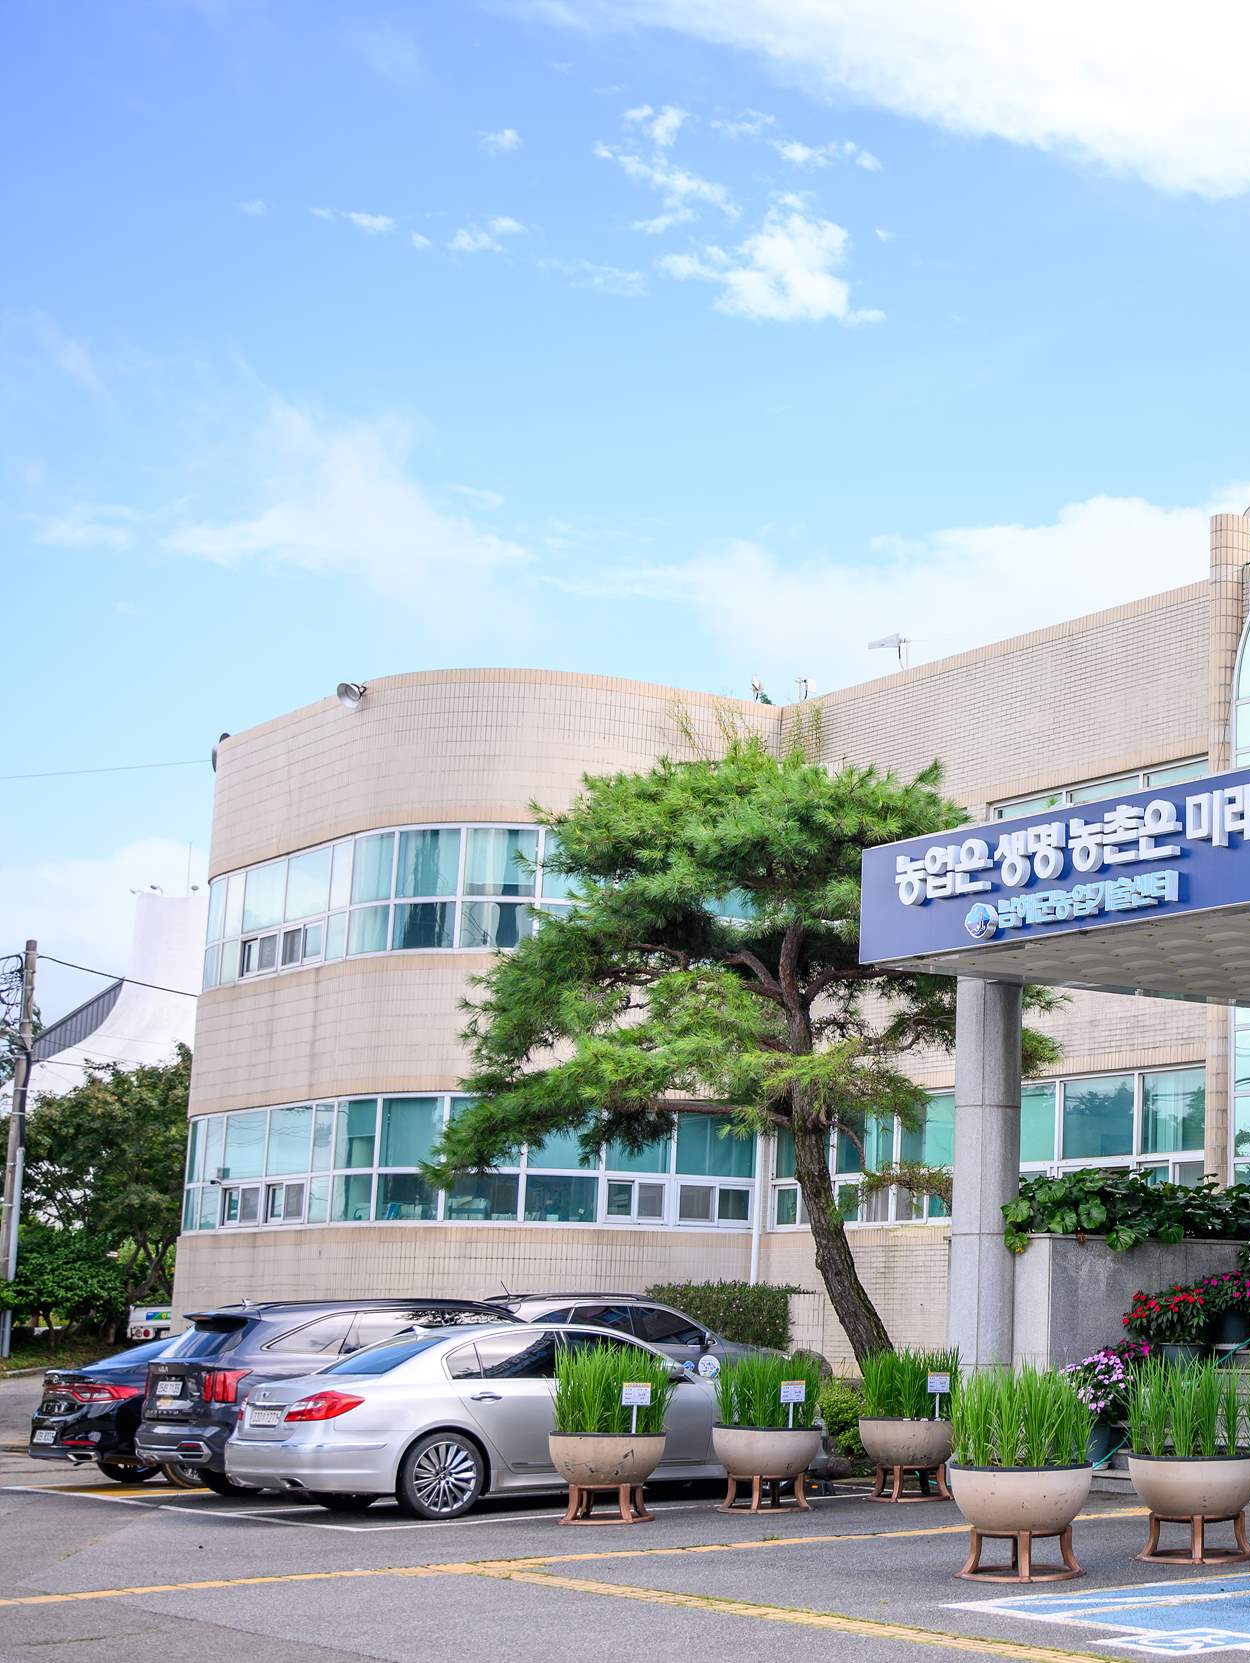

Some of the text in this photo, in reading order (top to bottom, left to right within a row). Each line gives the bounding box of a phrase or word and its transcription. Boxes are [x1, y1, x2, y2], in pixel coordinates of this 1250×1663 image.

[895, 838, 993, 906] 농업은
[994, 821, 1066, 887] 생명
[1068, 799, 1183, 873] 농촌은
